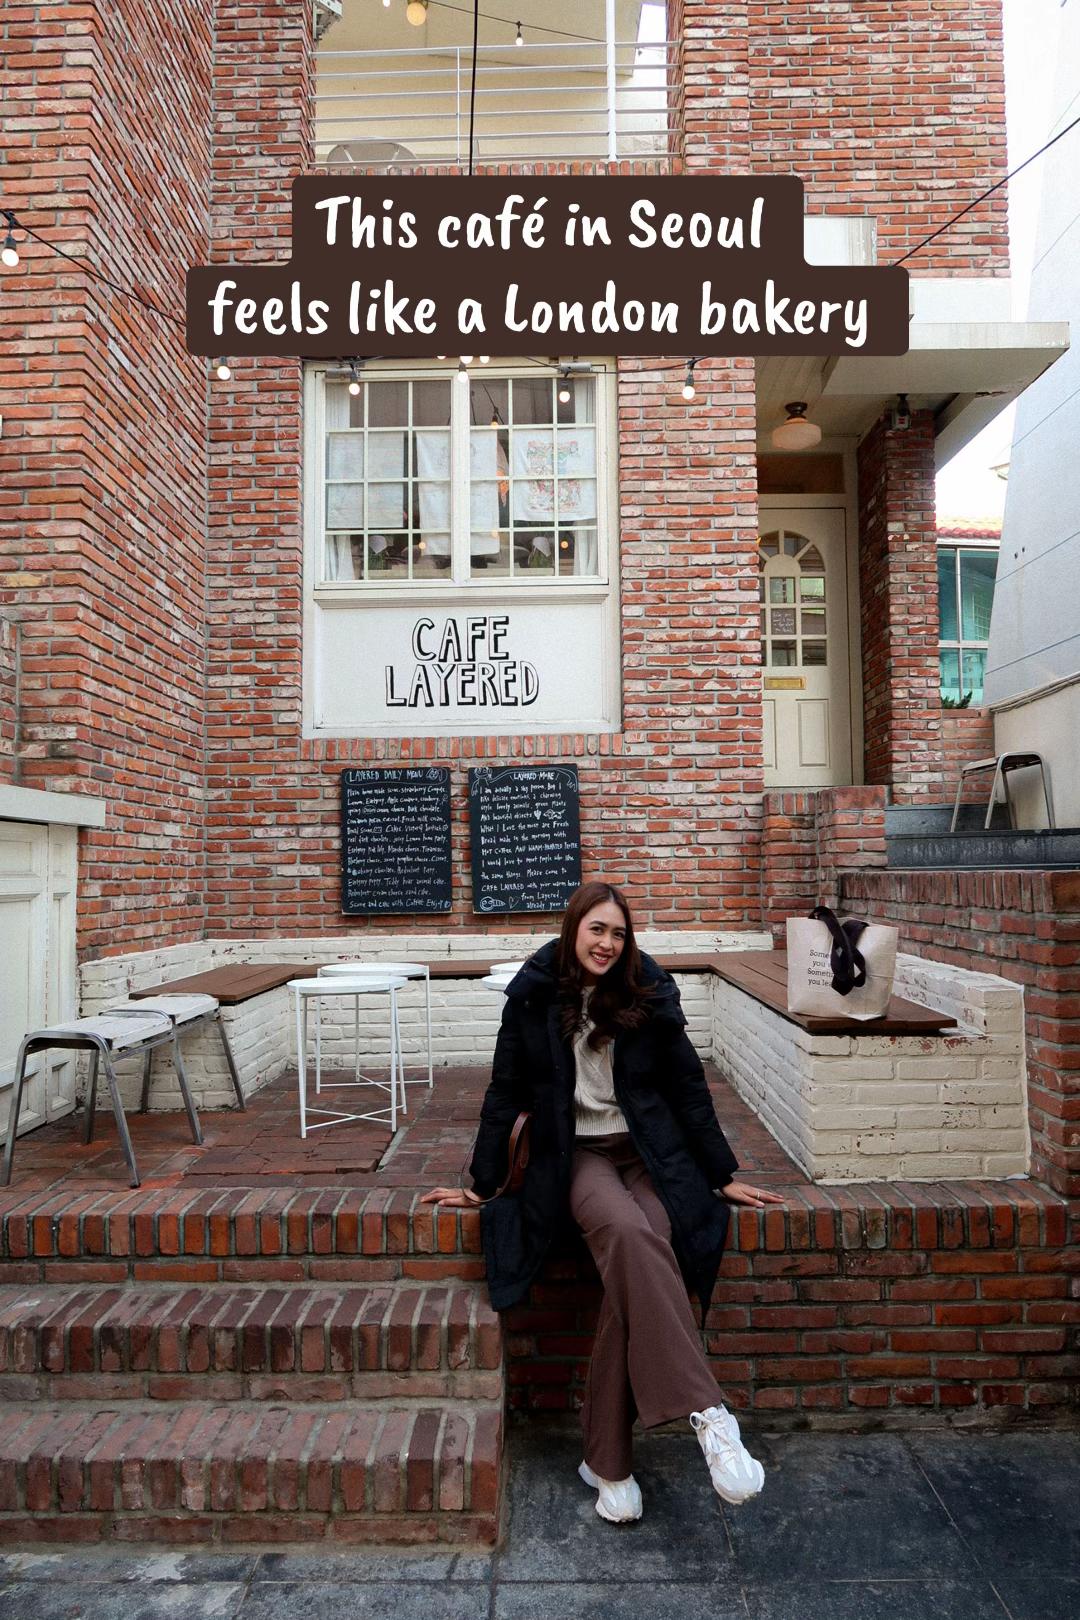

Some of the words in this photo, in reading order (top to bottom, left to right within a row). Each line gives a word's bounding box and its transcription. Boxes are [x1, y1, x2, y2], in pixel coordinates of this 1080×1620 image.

[411, 615, 510, 662] CAFE
[385, 660, 540, 708] LAYERED
[810, 950, 830, 958] Some
